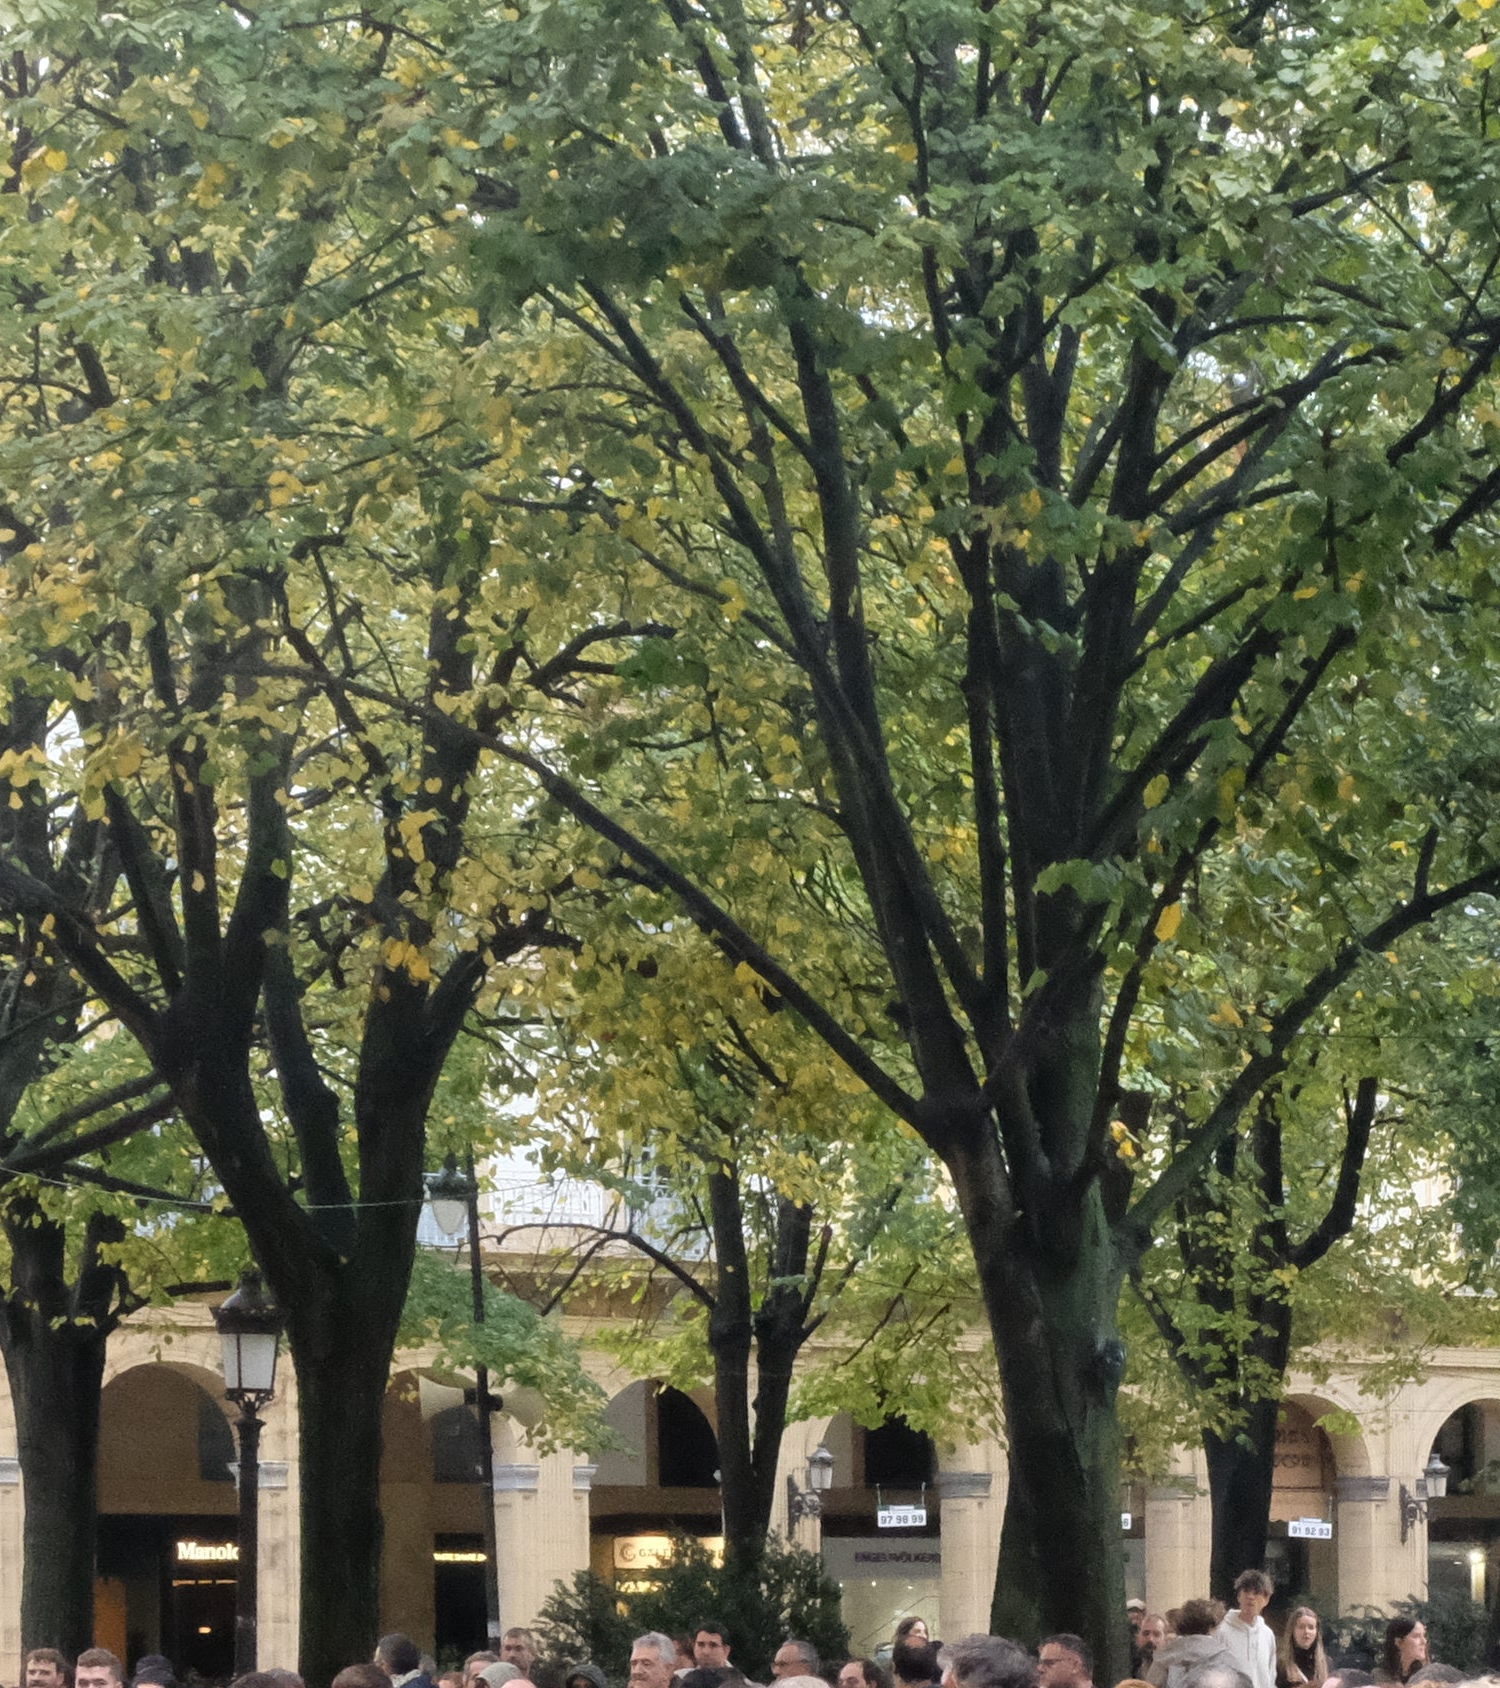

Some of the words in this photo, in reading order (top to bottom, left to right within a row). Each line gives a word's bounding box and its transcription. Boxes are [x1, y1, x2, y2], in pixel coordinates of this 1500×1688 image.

[881, 1515, 893, 1524] 97
[896, 1515, 908, 1524] 98
[911, 1514, 924, 1523] 99
